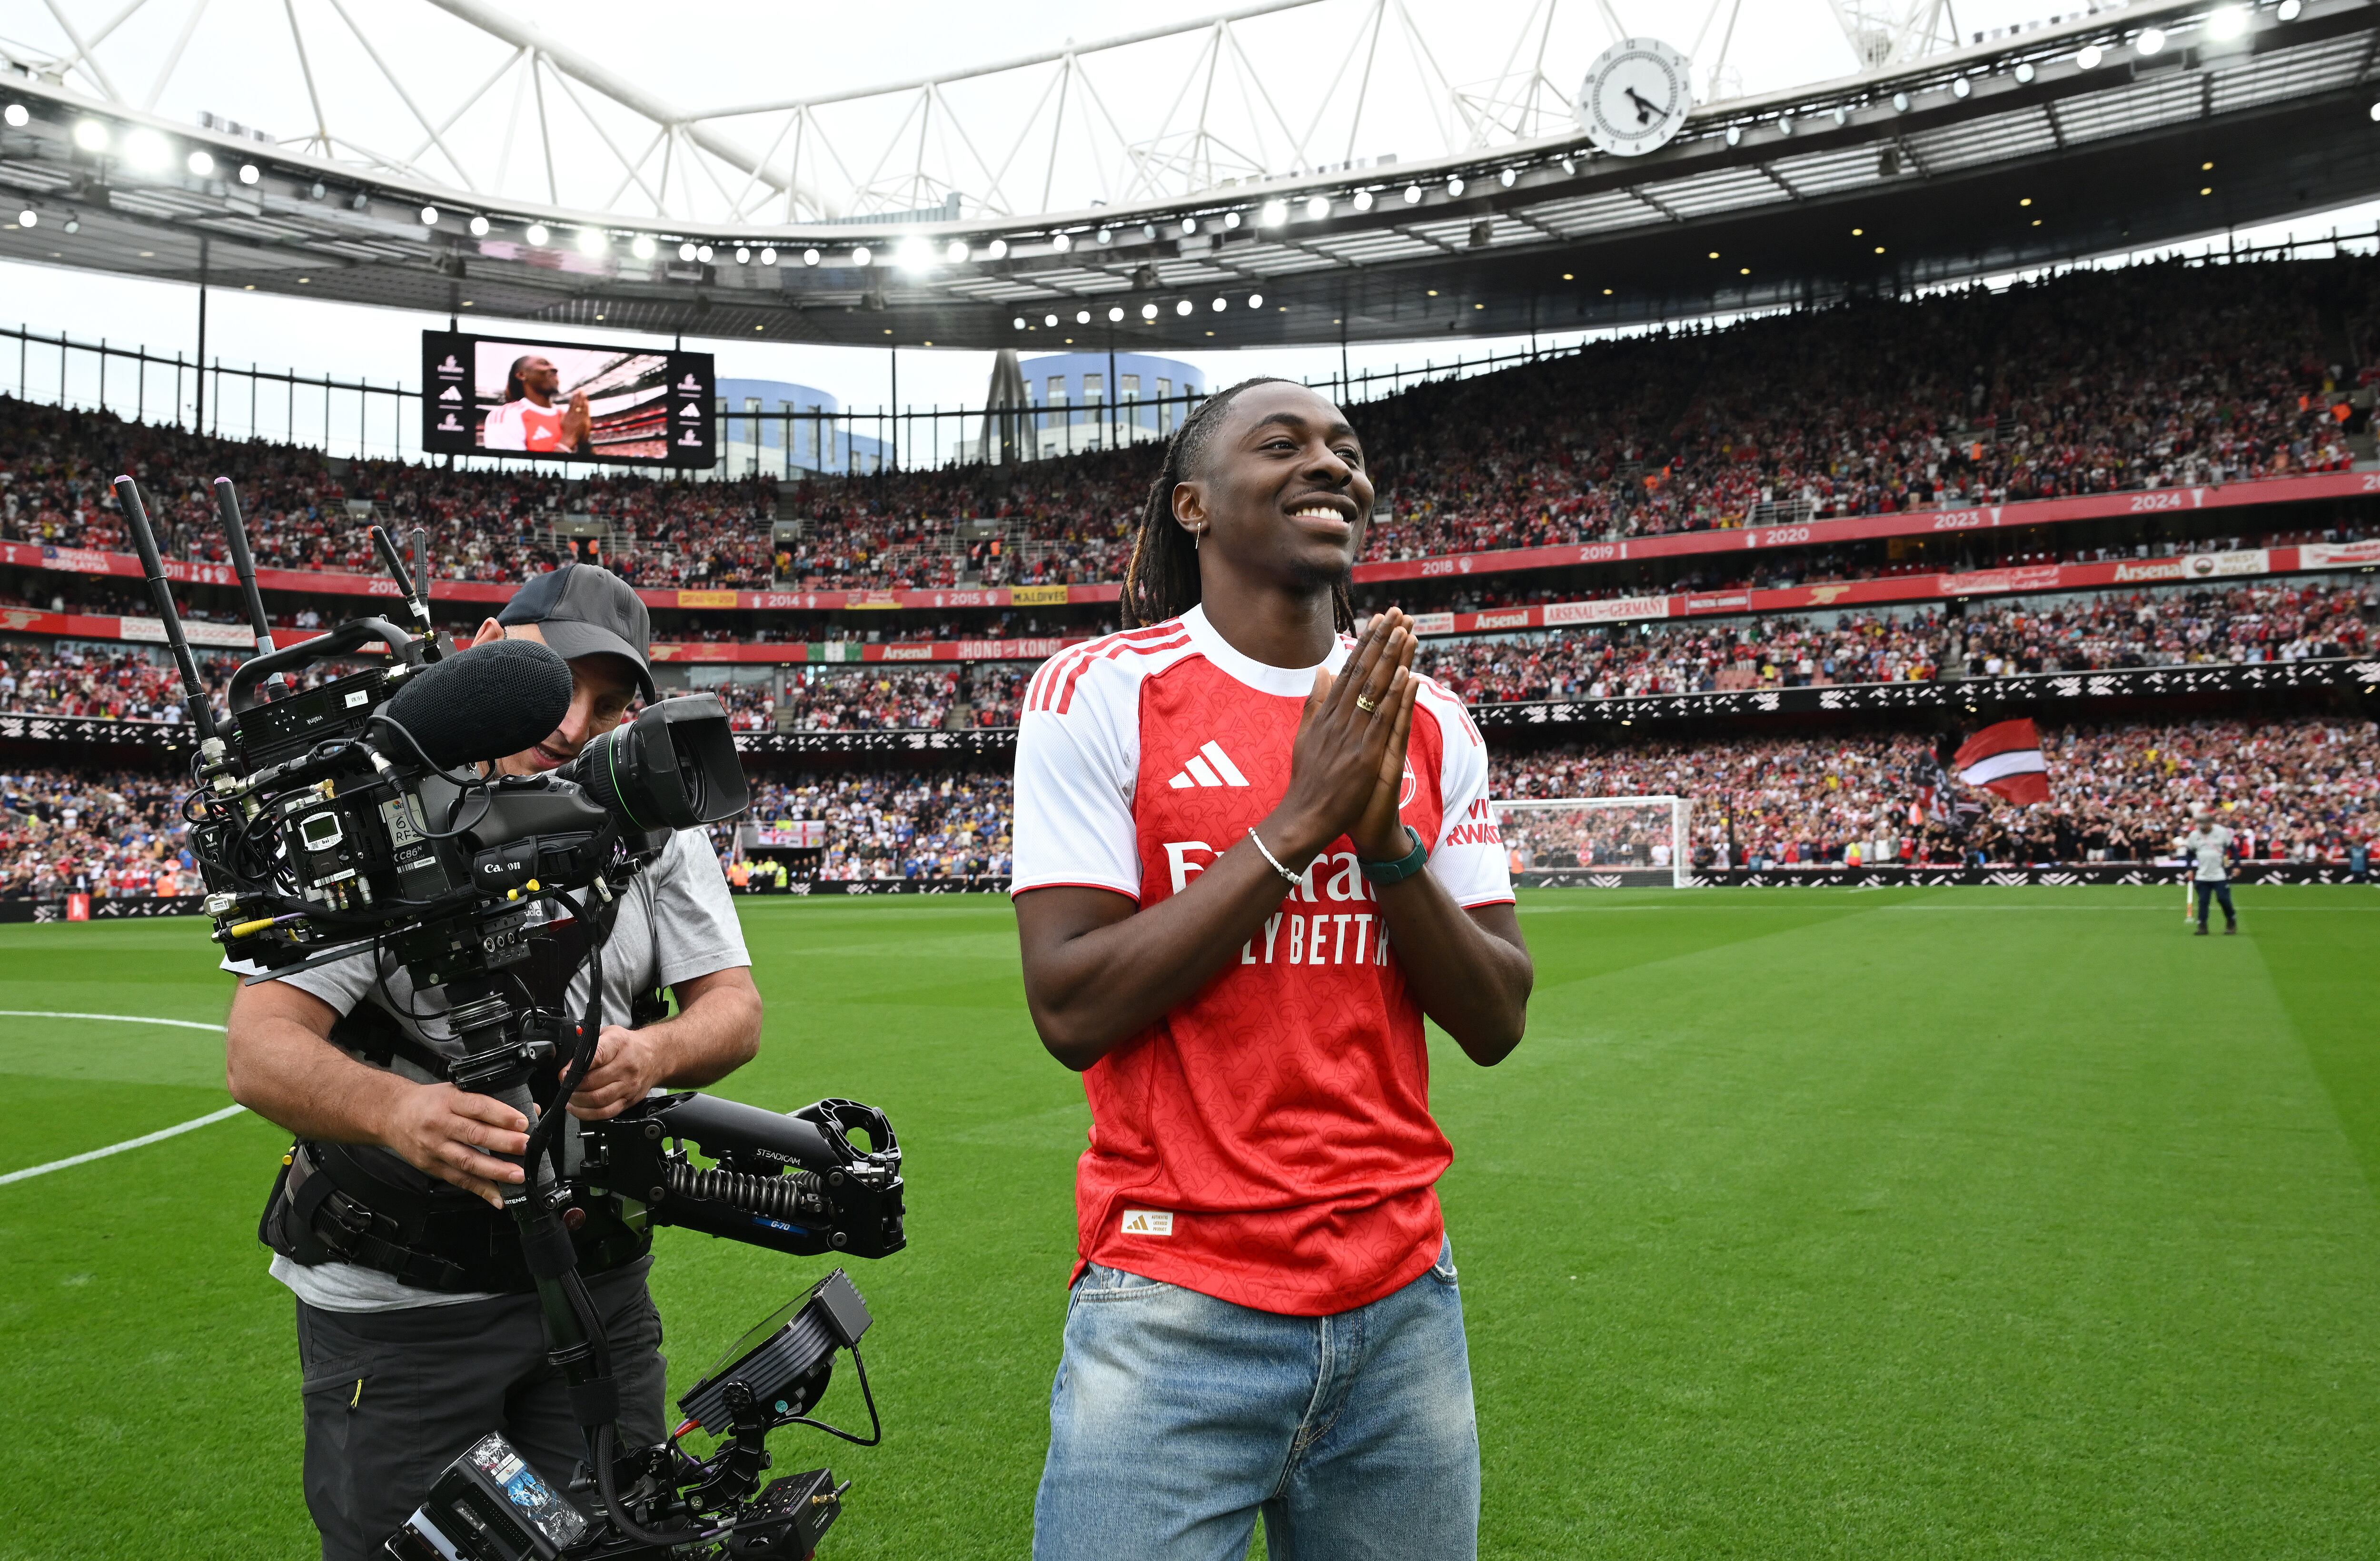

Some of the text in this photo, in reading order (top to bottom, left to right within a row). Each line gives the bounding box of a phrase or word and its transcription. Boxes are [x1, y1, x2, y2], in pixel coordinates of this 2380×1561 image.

[1626, 40, 1636, 49] 12
[1655, 41, 1659, 50] 1
[1602, 52, 1611, 60] 11
[1673, 56, 1680, 67] 2
[1586, 74, 1596, 84] 10
[1682, 82, 1688, 91] 3
[1583, 101, 1588, 110] 9
[1677, 109, 1683, 117] 4
[1591, 125, 1597, 134] 8
[1659, 131, 1666, 140] 5
[1609, 140, 1615, 149] 7
[1635, 142, 1641, 151] 6
[2131, 494, 2182, 511] 2024
[1934, 512, 1979, 529] 2023
[1766, 527, 1809, 545] 2020
[1580, 546, 1614, 561] 2019
[165, 565, 185, 578] 011
[1422, 561, 1453, 575] 2018
[768, 595, 800, 607] 2014
[950, 592, 981, 605] 2015
[1013, 590, 1067, 603] MALDIVES
[1548, 598, 1666, 620] ARSENAL GERMANY
[1475, 611, 1528, 629] Arsenal
[882, 643, 932, 660] Arsenal
[962, 641, 1002, 659] HONG
[1018, 639, 1055, 657] KONG
[306, 715, 323, 726] vislink
[396, 816, 406, 829] 6
[402, 853, 425, 864] WORLDCAM
[1241, 912, 1389, 967] LY BETTR
[756, 1148, 801, 1166] STEADICAM
[771, 1220, 791, 1231] G-70
